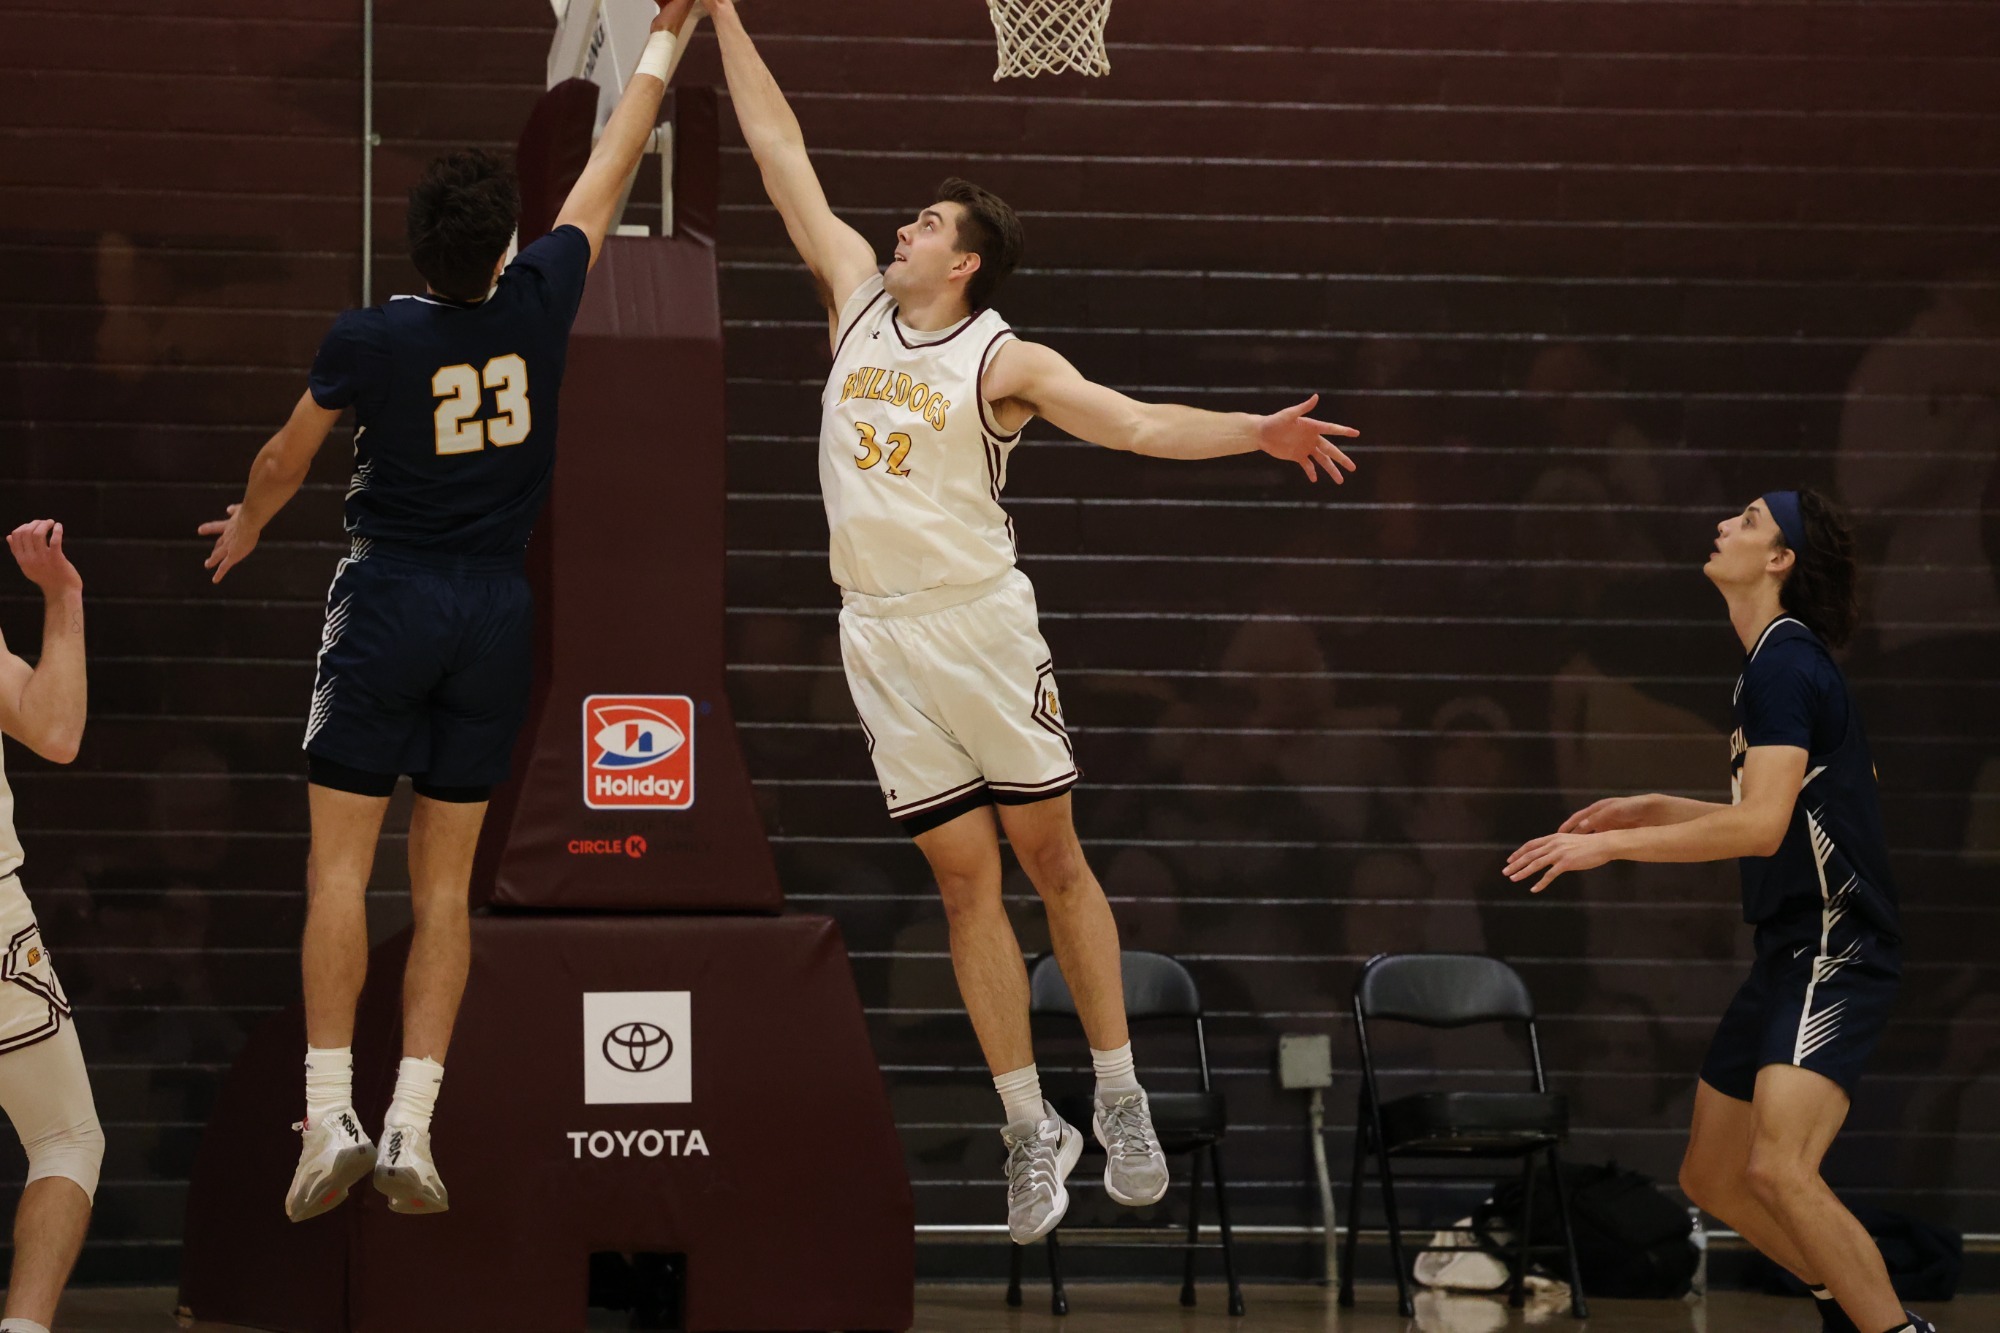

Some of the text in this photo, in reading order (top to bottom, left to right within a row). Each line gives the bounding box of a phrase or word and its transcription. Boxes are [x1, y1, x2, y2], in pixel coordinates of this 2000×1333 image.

[431, 352, 532, 456] 23
[837, 366, 951, 432] BULLDOGS
[853, 421, 912, 478] 32
[595, 774, 684, 801] Holiday
[567, 840, 622, 854] CIRCLE
[625, 834, 647, 859] K
[566, 1128, 710, 1159] TOYOTA
